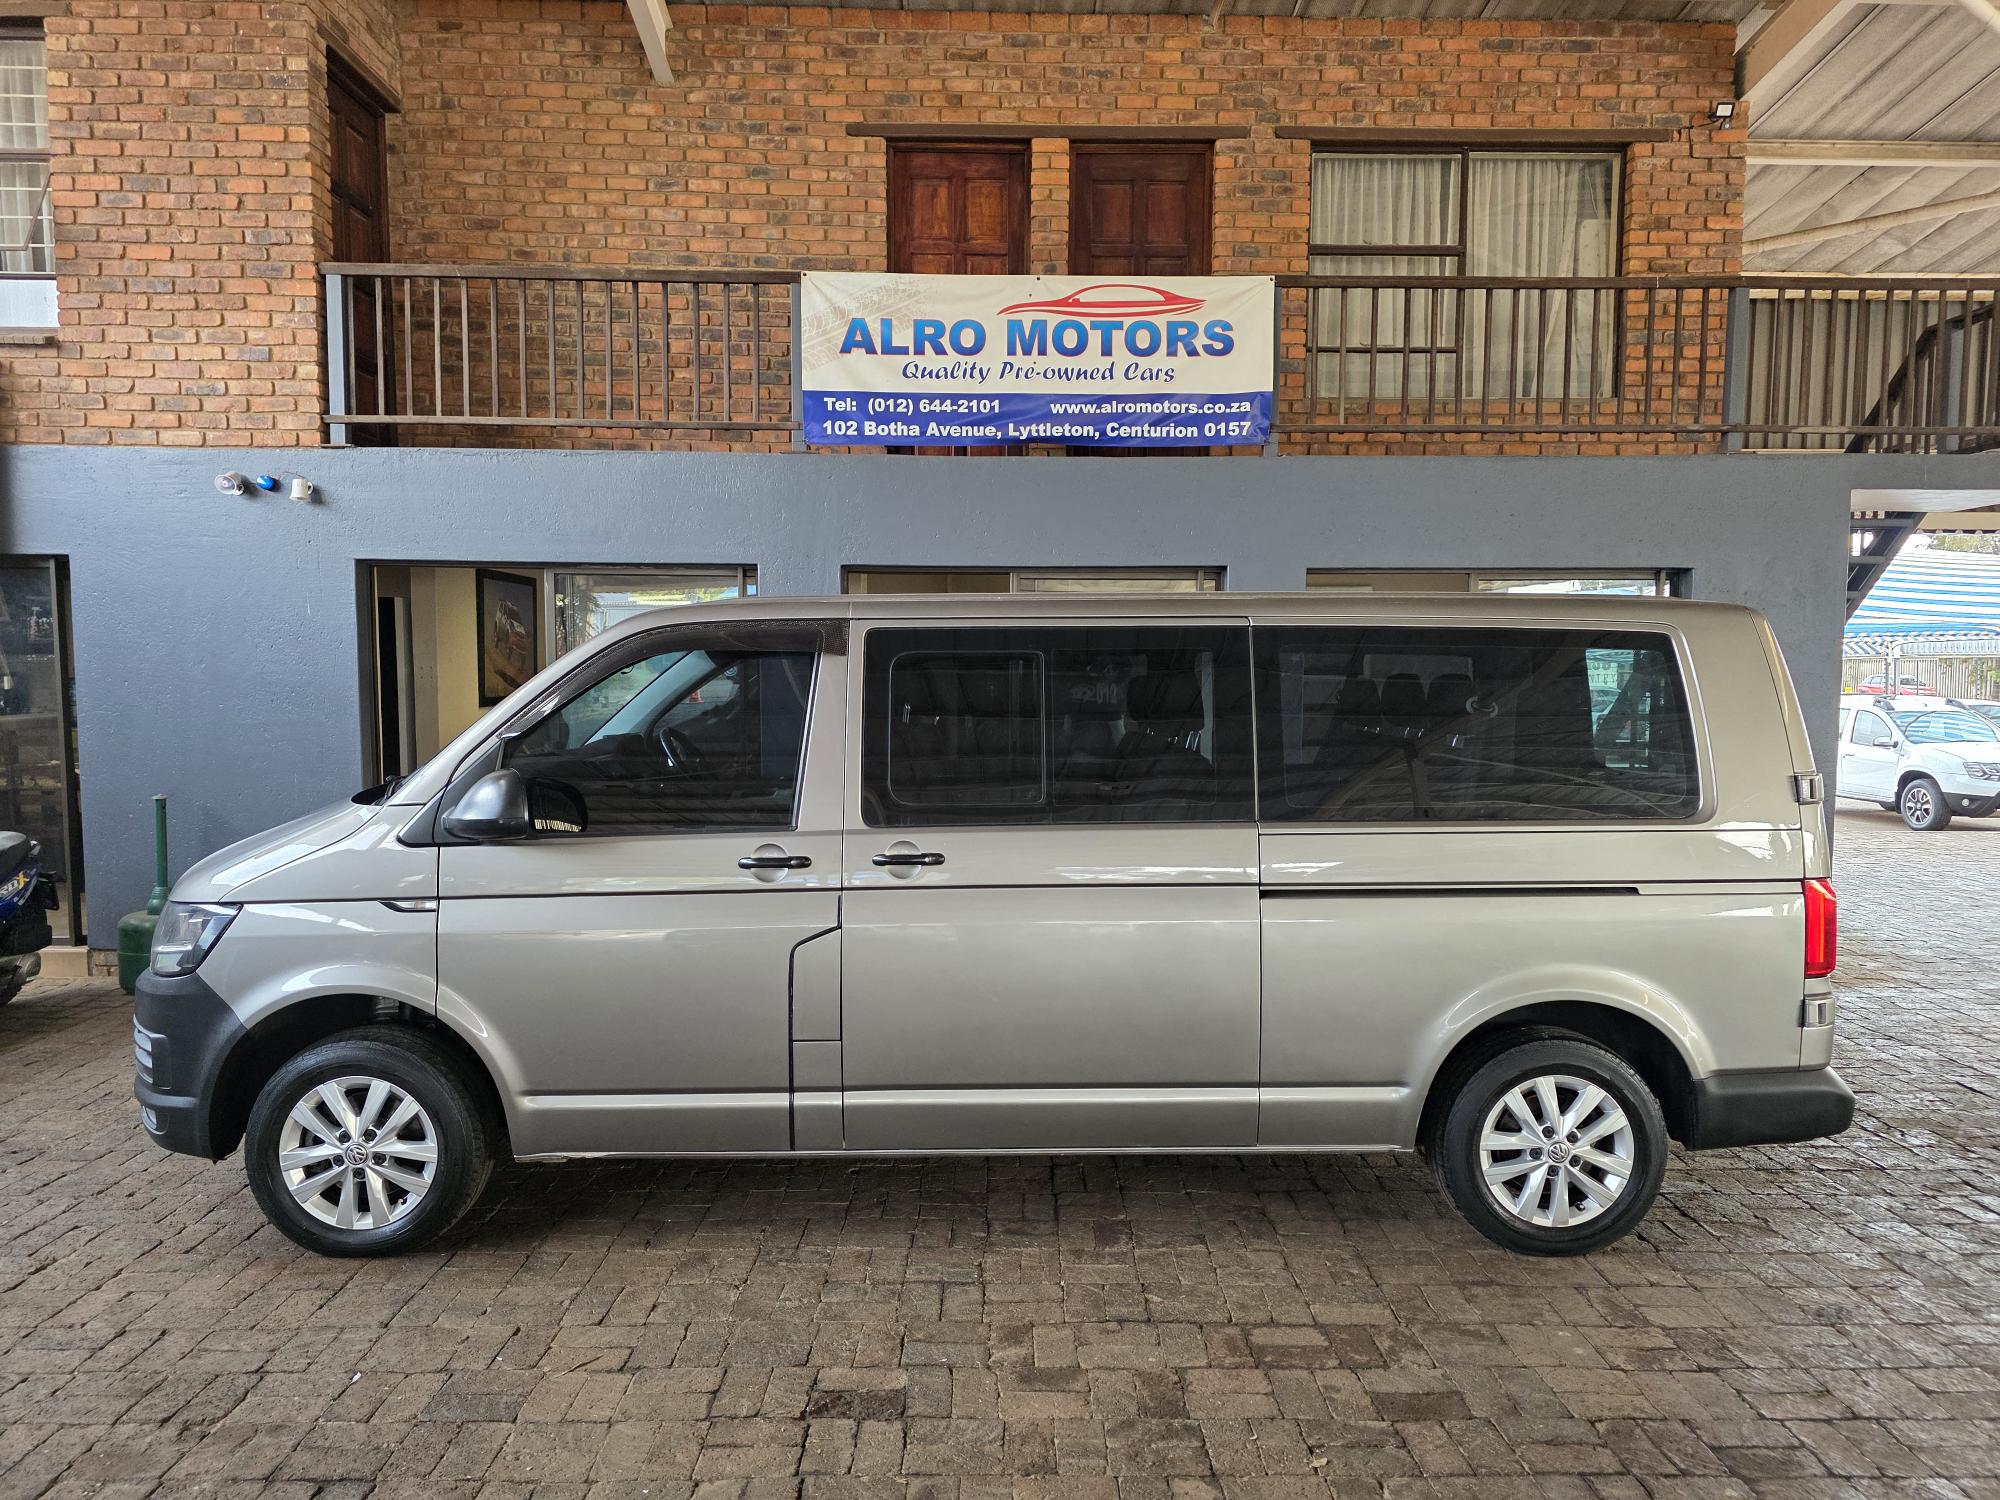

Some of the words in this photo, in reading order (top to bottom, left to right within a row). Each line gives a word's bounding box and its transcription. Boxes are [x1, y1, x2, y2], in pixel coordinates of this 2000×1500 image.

[839, 317, 987, 357] ALRO
[1006, 319, 1235, 358] MOTORS
[902, 361, 991, 385] Quality
[999, 361, 1116, 382] Pre-owned
[1124, 362, 1176, 383] Cars
[823, 397, 857, 412] Tel:
[868, 398, 914, 416] (012)
[919, 399, 1000, 413] 644-2101
[1050, 400, 1251, 414] www.alromotors.co.za
[823, 420, 858, 436] 102
[864, 421, 920, 437] Botha
[926, 422, 1002, 439] Avenue,
[1008, 422, 1100, 440] Lyttleton,
[1106, 422, 1198, 437] Centurion
[1204, 421, 1251, 437] 0157
